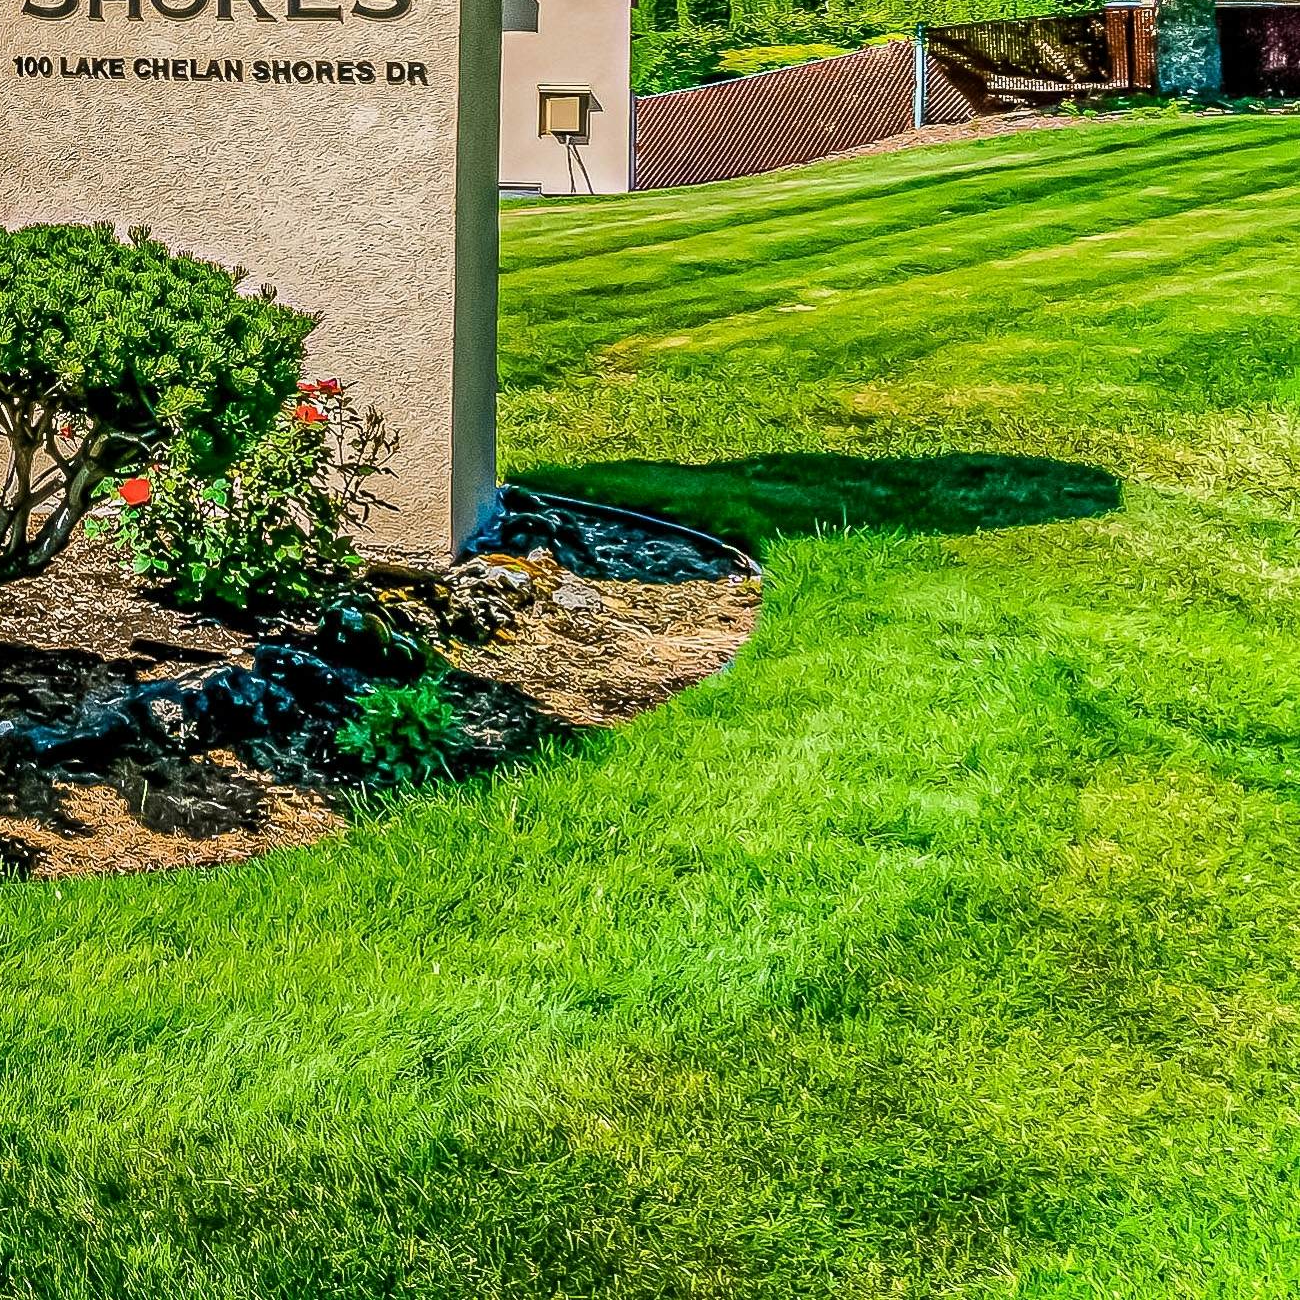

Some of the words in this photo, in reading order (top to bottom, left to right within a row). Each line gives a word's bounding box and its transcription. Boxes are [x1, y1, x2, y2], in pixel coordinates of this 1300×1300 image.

[12, 55, 54, 78] 100
[60, 56, 126, 80] LAKE
[133, 57, 244, 82] CHELAN
[251, 59, 377, 85] SHORES
[385, 61, 430, 87] DR
